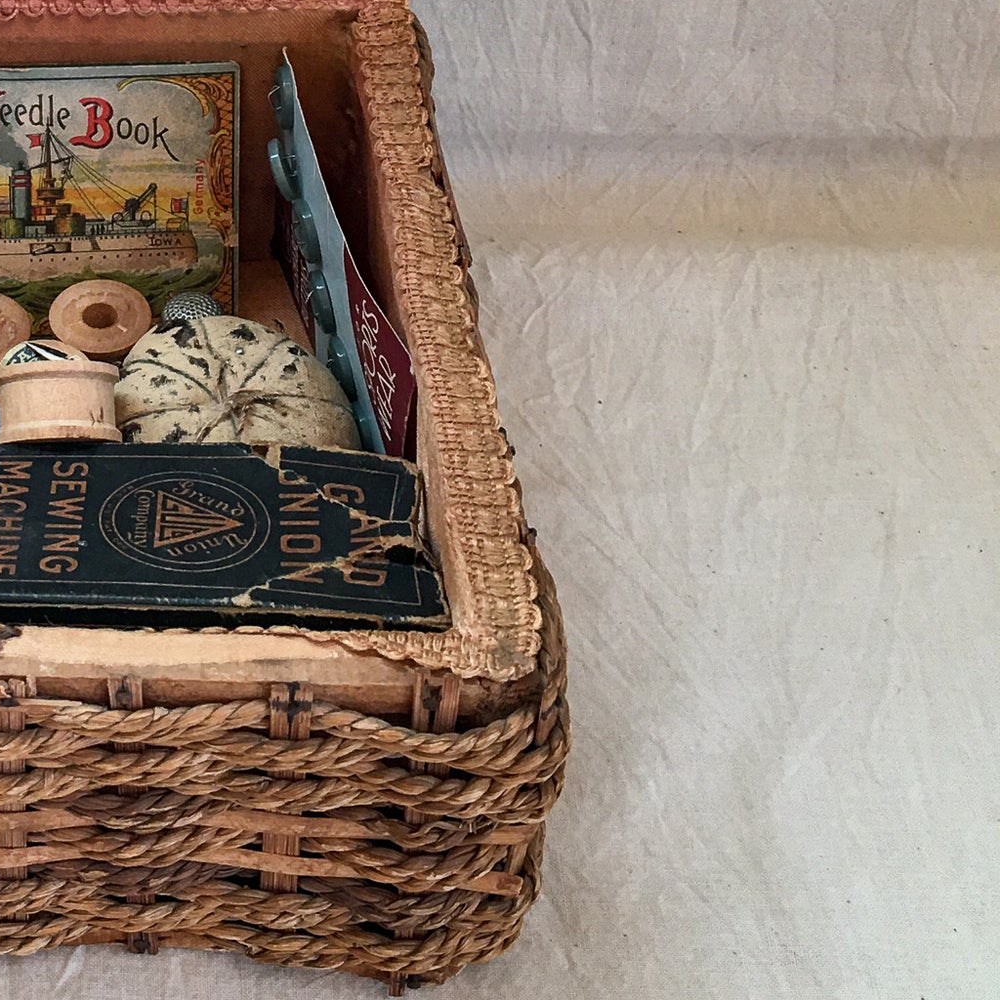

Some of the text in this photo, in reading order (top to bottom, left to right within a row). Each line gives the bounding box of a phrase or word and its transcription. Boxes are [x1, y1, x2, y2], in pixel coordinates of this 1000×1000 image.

[69, 97, 180, 162] Book
[193, 158, 207, 215] Germany
[39, 460, 89, 574] SEWING
[127, 489, 156, 548] Company
[172, 479, 245, 517] Grand
[167, 532, 248, 557] Union
